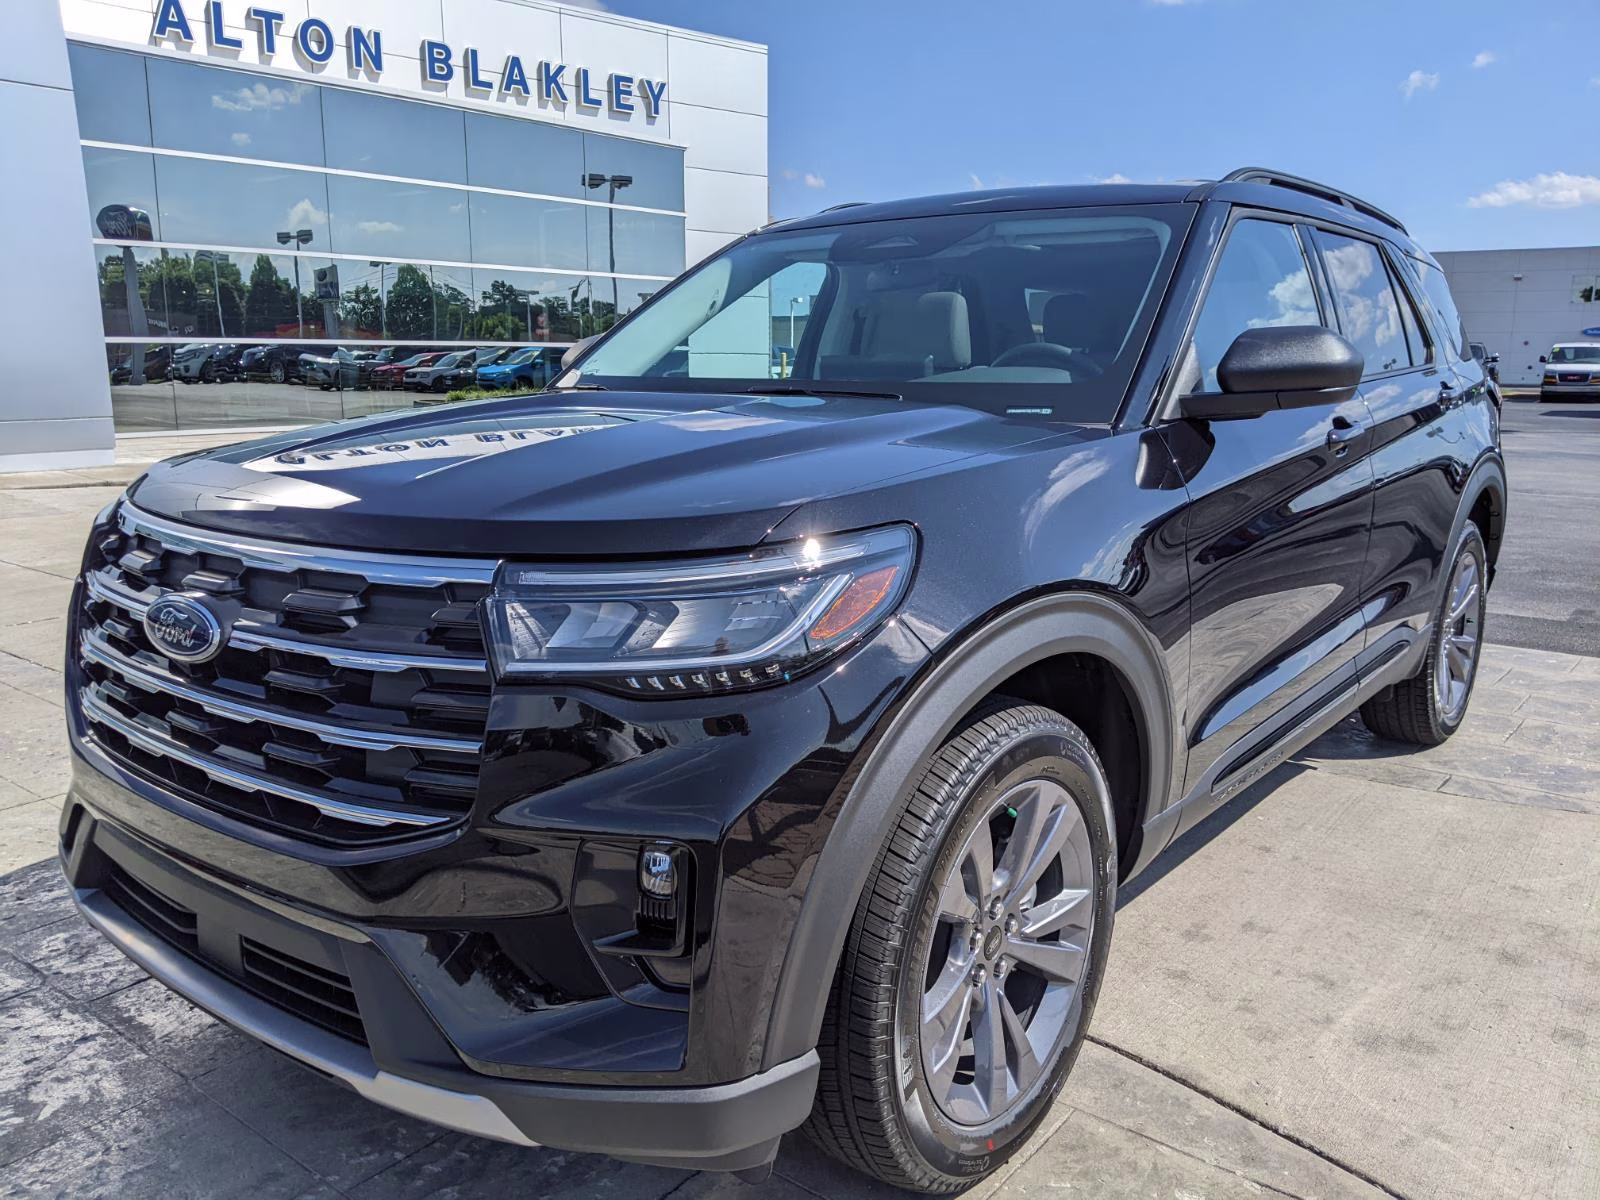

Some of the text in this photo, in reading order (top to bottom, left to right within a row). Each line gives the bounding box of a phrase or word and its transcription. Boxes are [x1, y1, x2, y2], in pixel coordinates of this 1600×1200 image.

[153, 0, 667, 116] ALTON BLAKLEY
[155, 607, 197, 648] Ford
